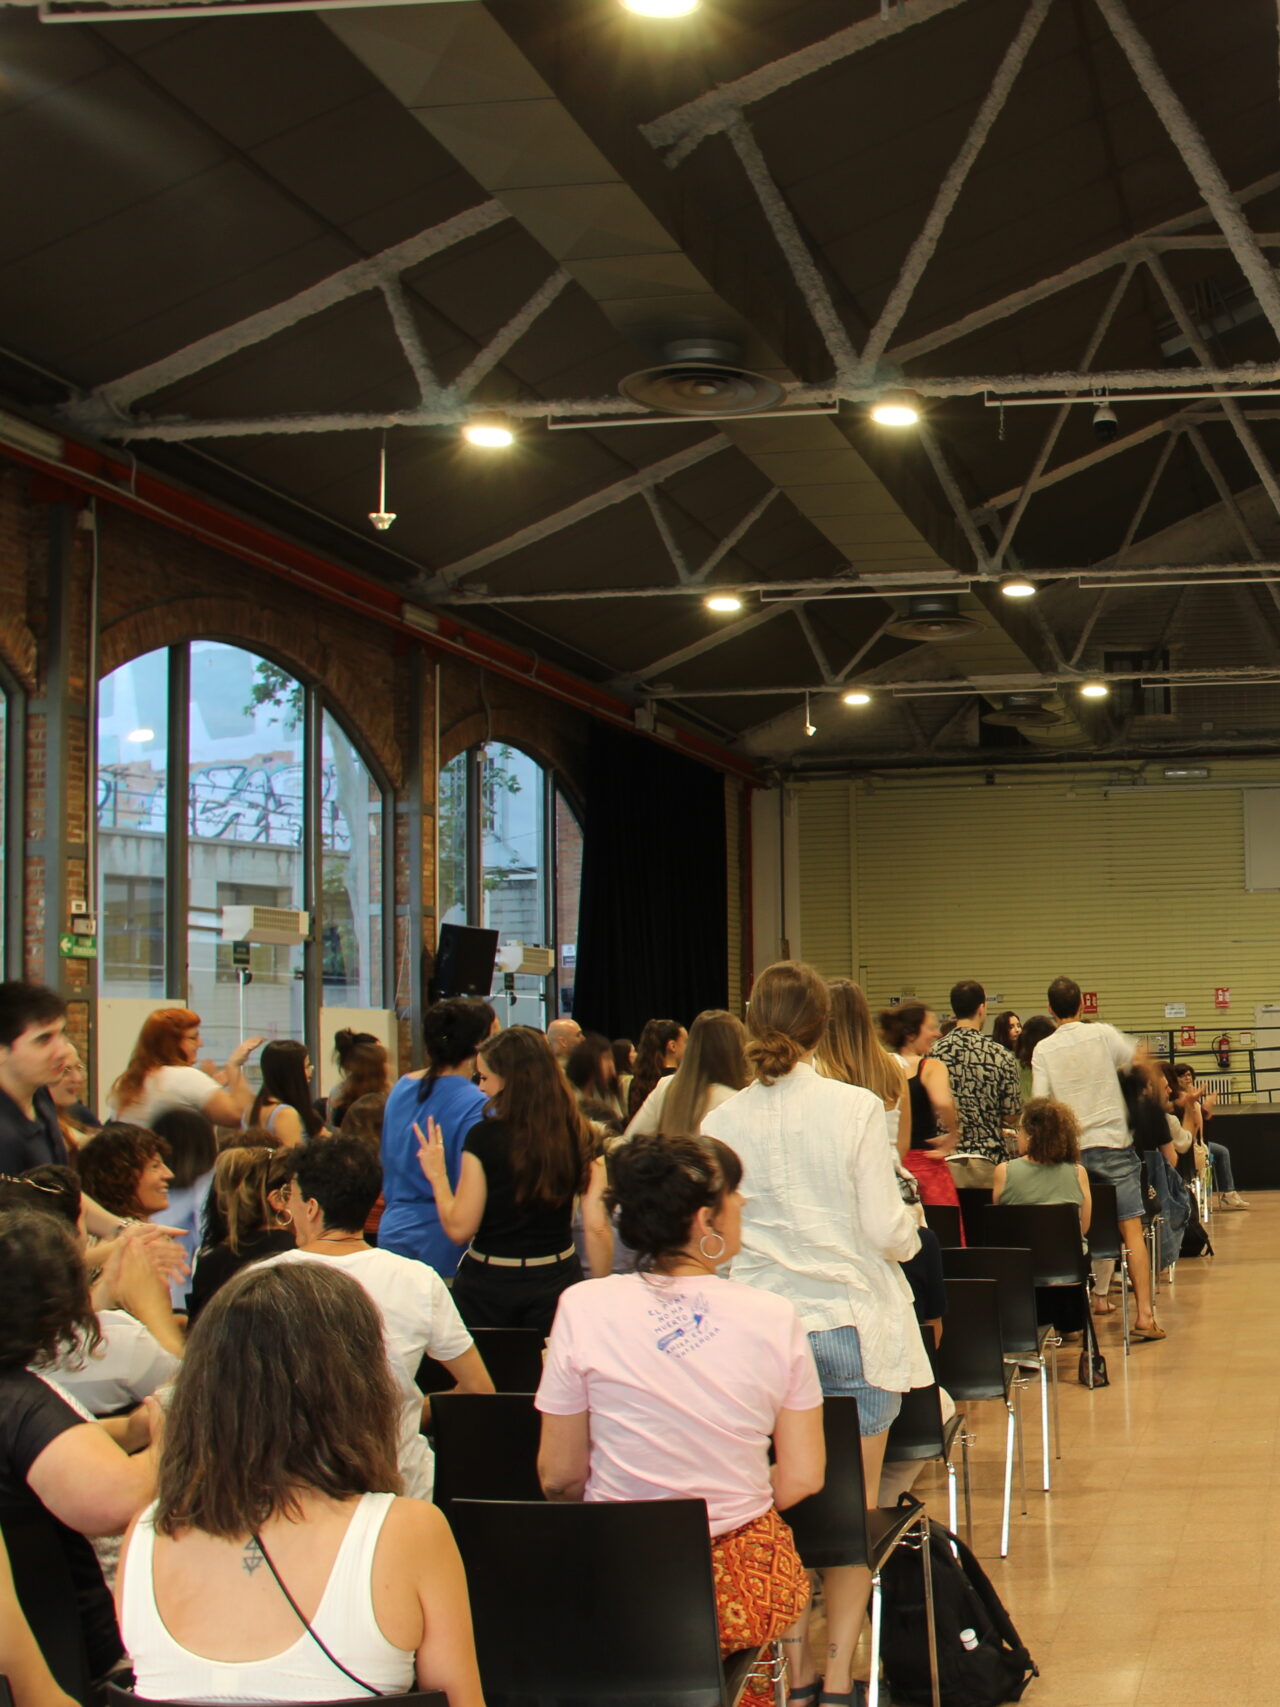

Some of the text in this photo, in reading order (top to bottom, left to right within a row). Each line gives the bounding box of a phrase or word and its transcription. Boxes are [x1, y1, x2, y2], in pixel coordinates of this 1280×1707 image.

[657, 1306, 684, 1322] NO HA
[654, 1314, 689, 1334] MUERTO
